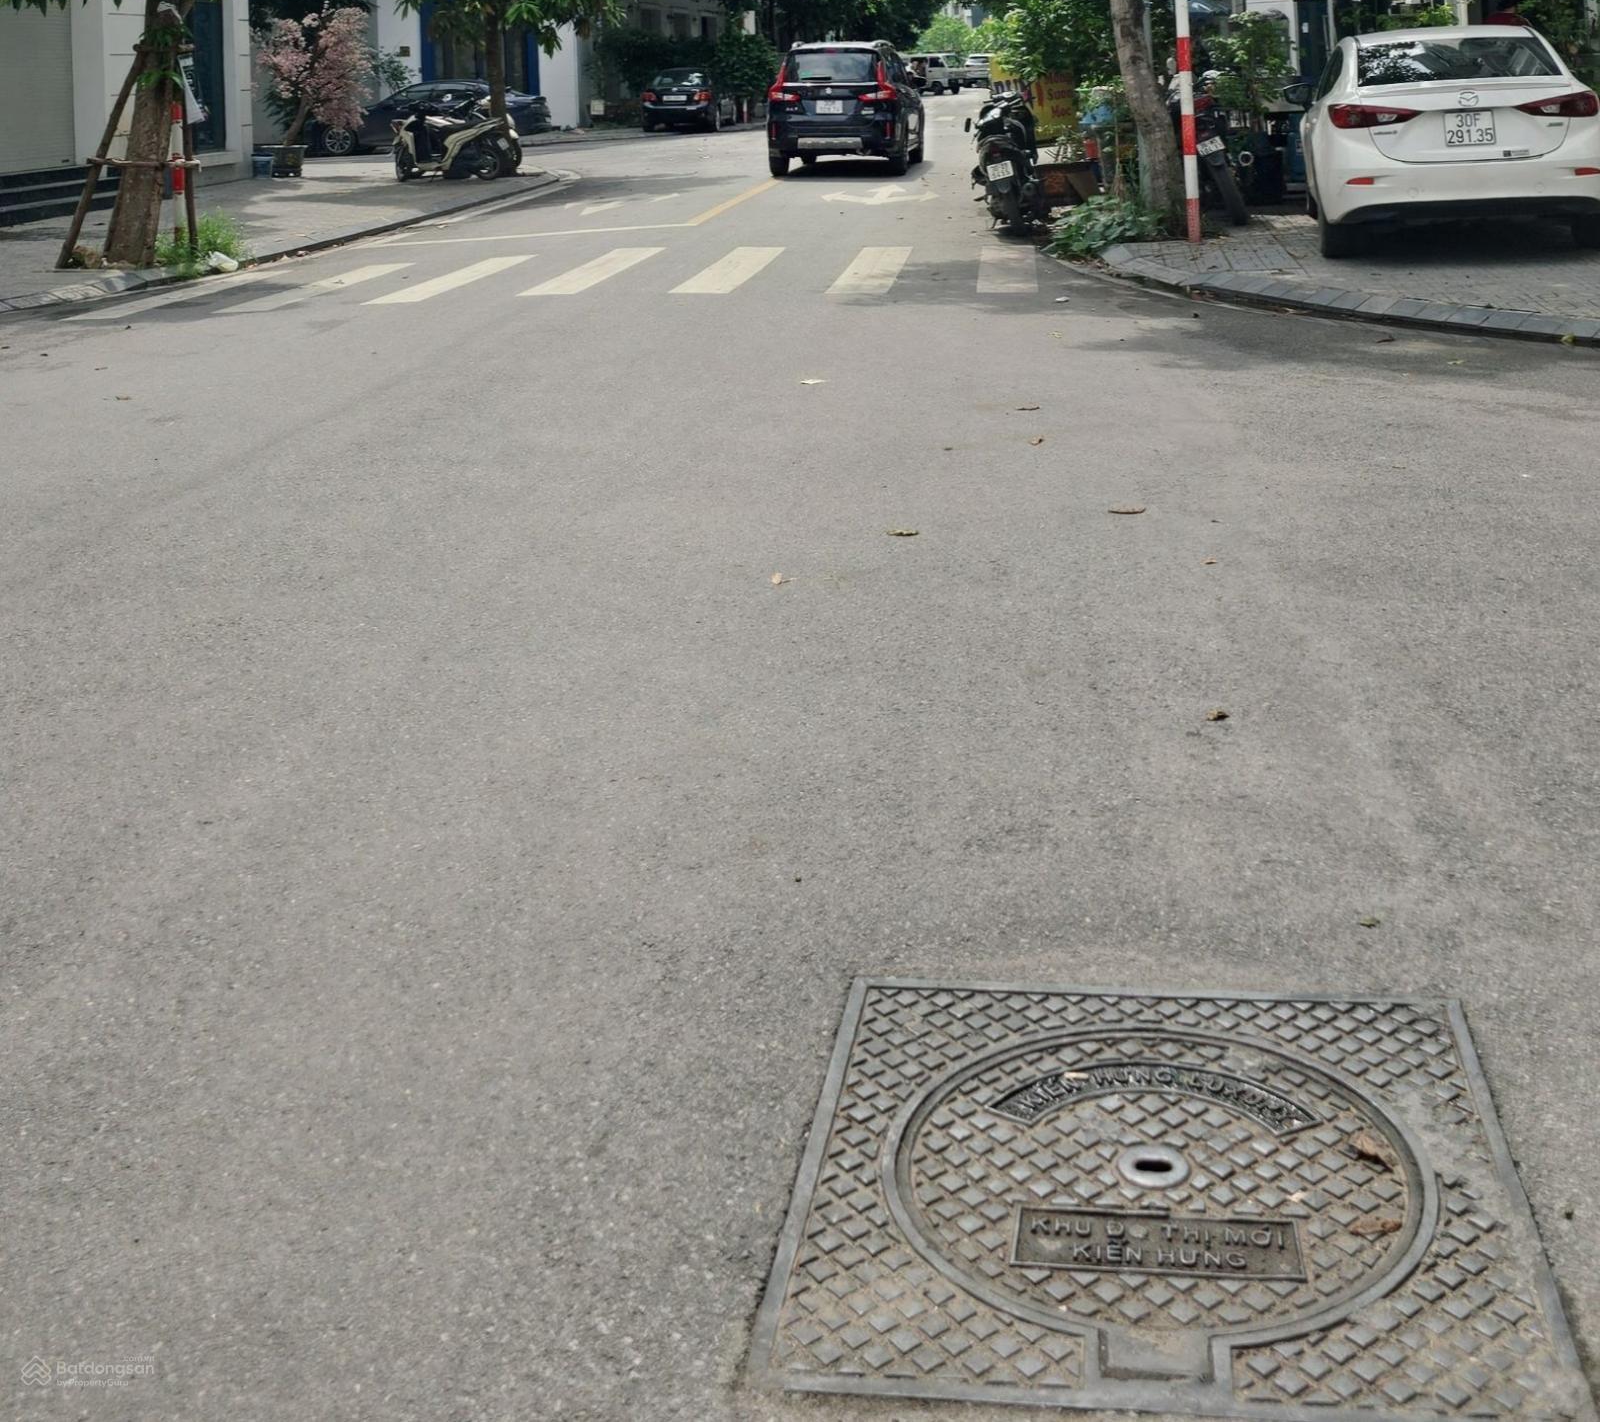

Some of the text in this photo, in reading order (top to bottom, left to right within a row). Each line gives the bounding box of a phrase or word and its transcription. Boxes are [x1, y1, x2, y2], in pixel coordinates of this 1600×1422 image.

[1456, 113, 1481, 128] 30F
[1447, 128, 1494, 144] 291.35
[1031, 1216, 1091, 1238] KHU
